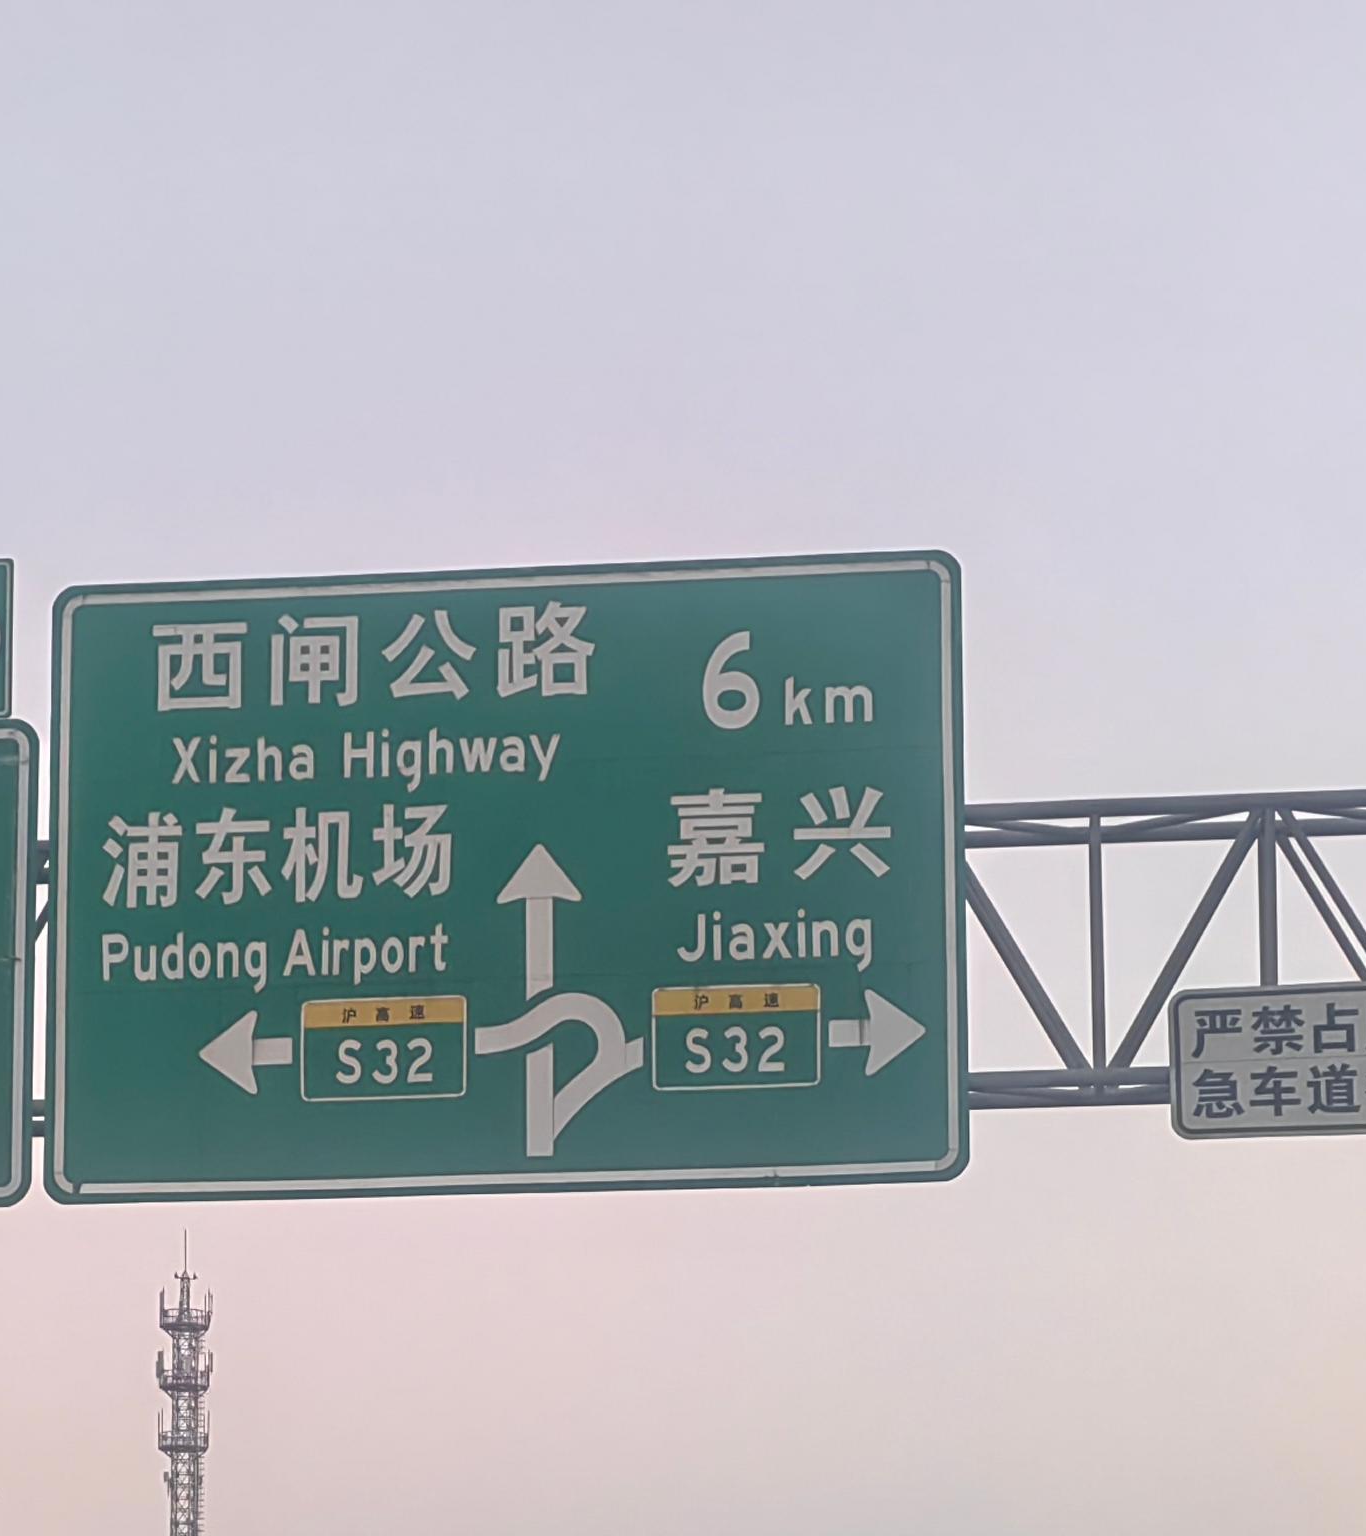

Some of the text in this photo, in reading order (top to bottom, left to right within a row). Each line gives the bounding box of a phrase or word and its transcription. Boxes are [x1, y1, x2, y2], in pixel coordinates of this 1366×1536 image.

[152, 600, 596, 714] 西闸公路
[701, 630, 874, 730] 6 km
[171, 730, 561, 791] Xizha Highway
[101, 803, 454, 909] 浦东机场
[666, 786, 892, 889] 嘉兴
[101, 923, 450, 991] Pudong Airport
[677, 909, 873, 971] Jiaxing
[341, 1004, 425, 1024] 沪高速
[693, 992, 780, 1011] 沪高速
[336, 1037, 433, 1084] S32
[685, 1025, 785, 1074] S32
